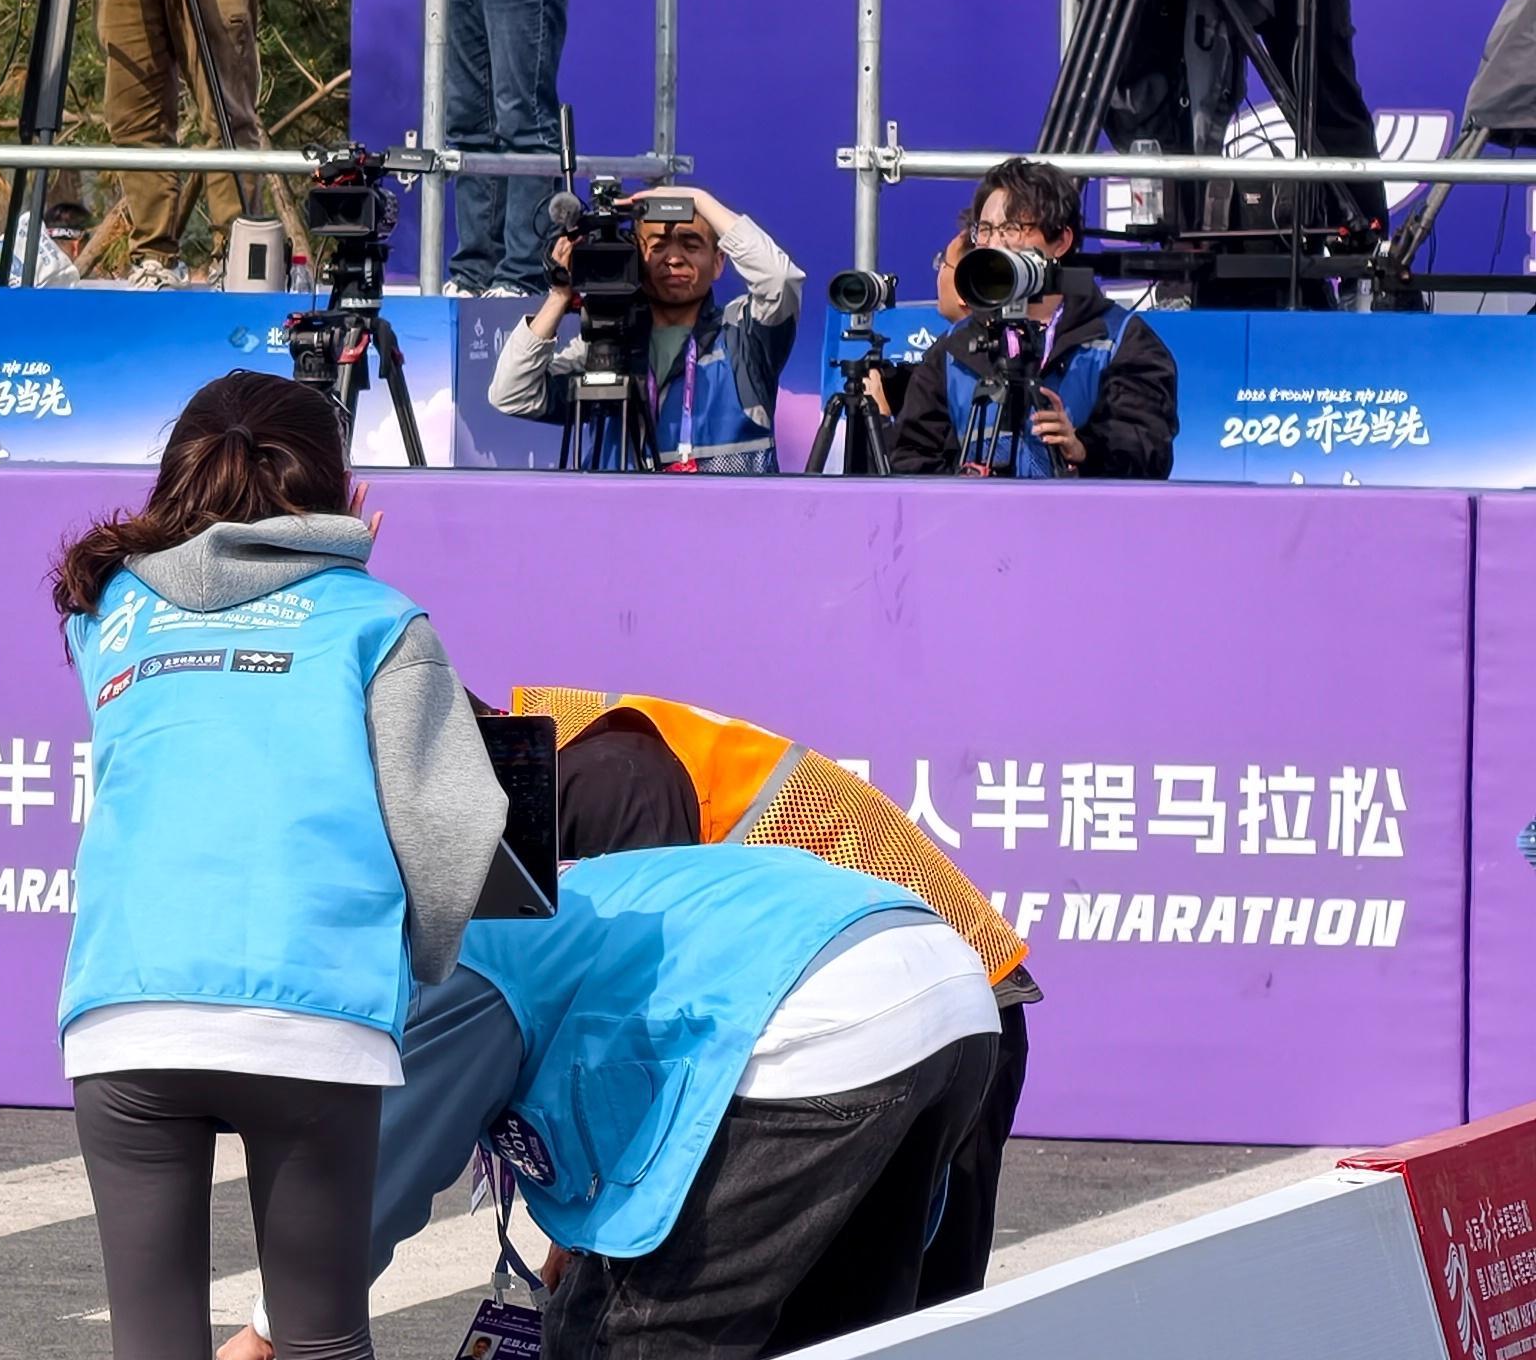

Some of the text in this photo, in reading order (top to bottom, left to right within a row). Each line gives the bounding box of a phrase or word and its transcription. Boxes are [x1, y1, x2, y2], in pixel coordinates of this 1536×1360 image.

[21, 361, 51, 375] LEAD
[1376, 389, 1409, 404] LEAD
[1220, 404, 1430, 454] 2026 亦马当先
[835, 757, 1408, 859] 人半程马拉松
[1059, 892, 1406, 948] MARATHON
